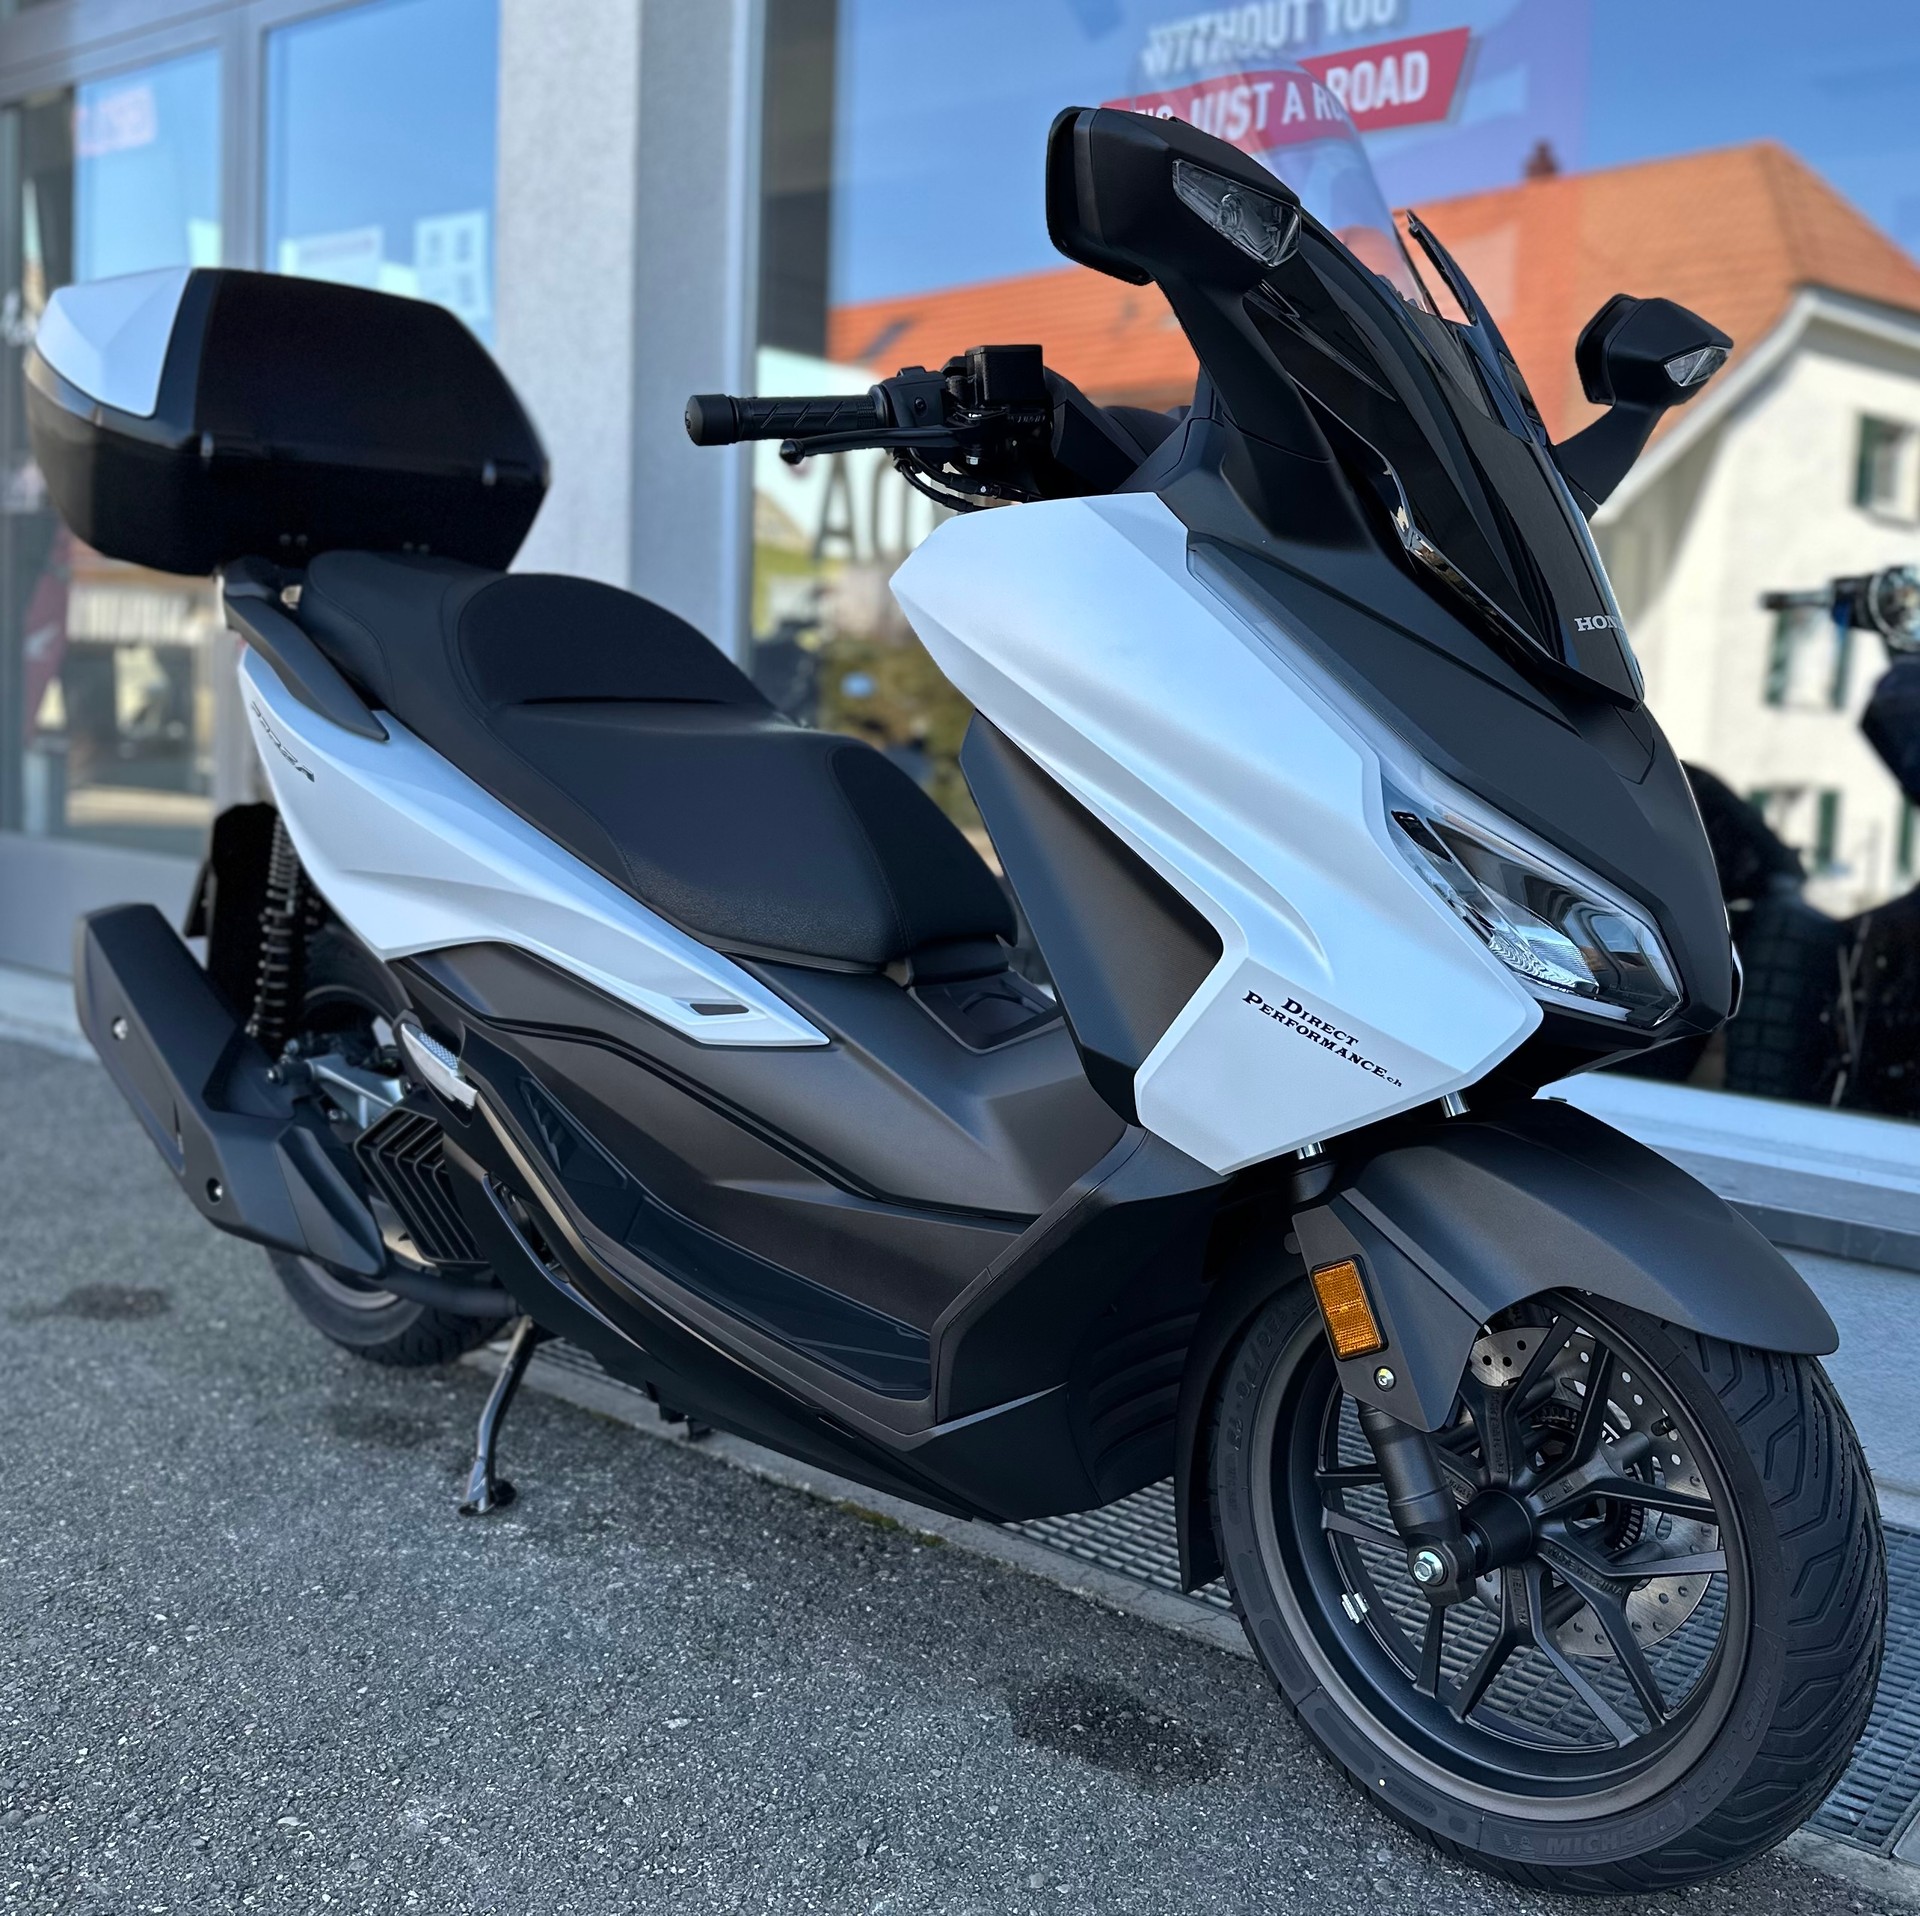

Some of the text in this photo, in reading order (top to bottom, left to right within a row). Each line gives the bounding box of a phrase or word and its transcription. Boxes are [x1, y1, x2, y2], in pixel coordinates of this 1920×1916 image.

[1281, 81, 1306, 126] A
[1313, 50, 1430, 121] ROAD
[1574, 614, 1621, 632] HON
[1242, 989, 1403, 1088] PERFORMANCE.ch
[1280, 997, 1360, 1047] DIRECT
[1546, 1799, 1685, 1856] MICHELIN
